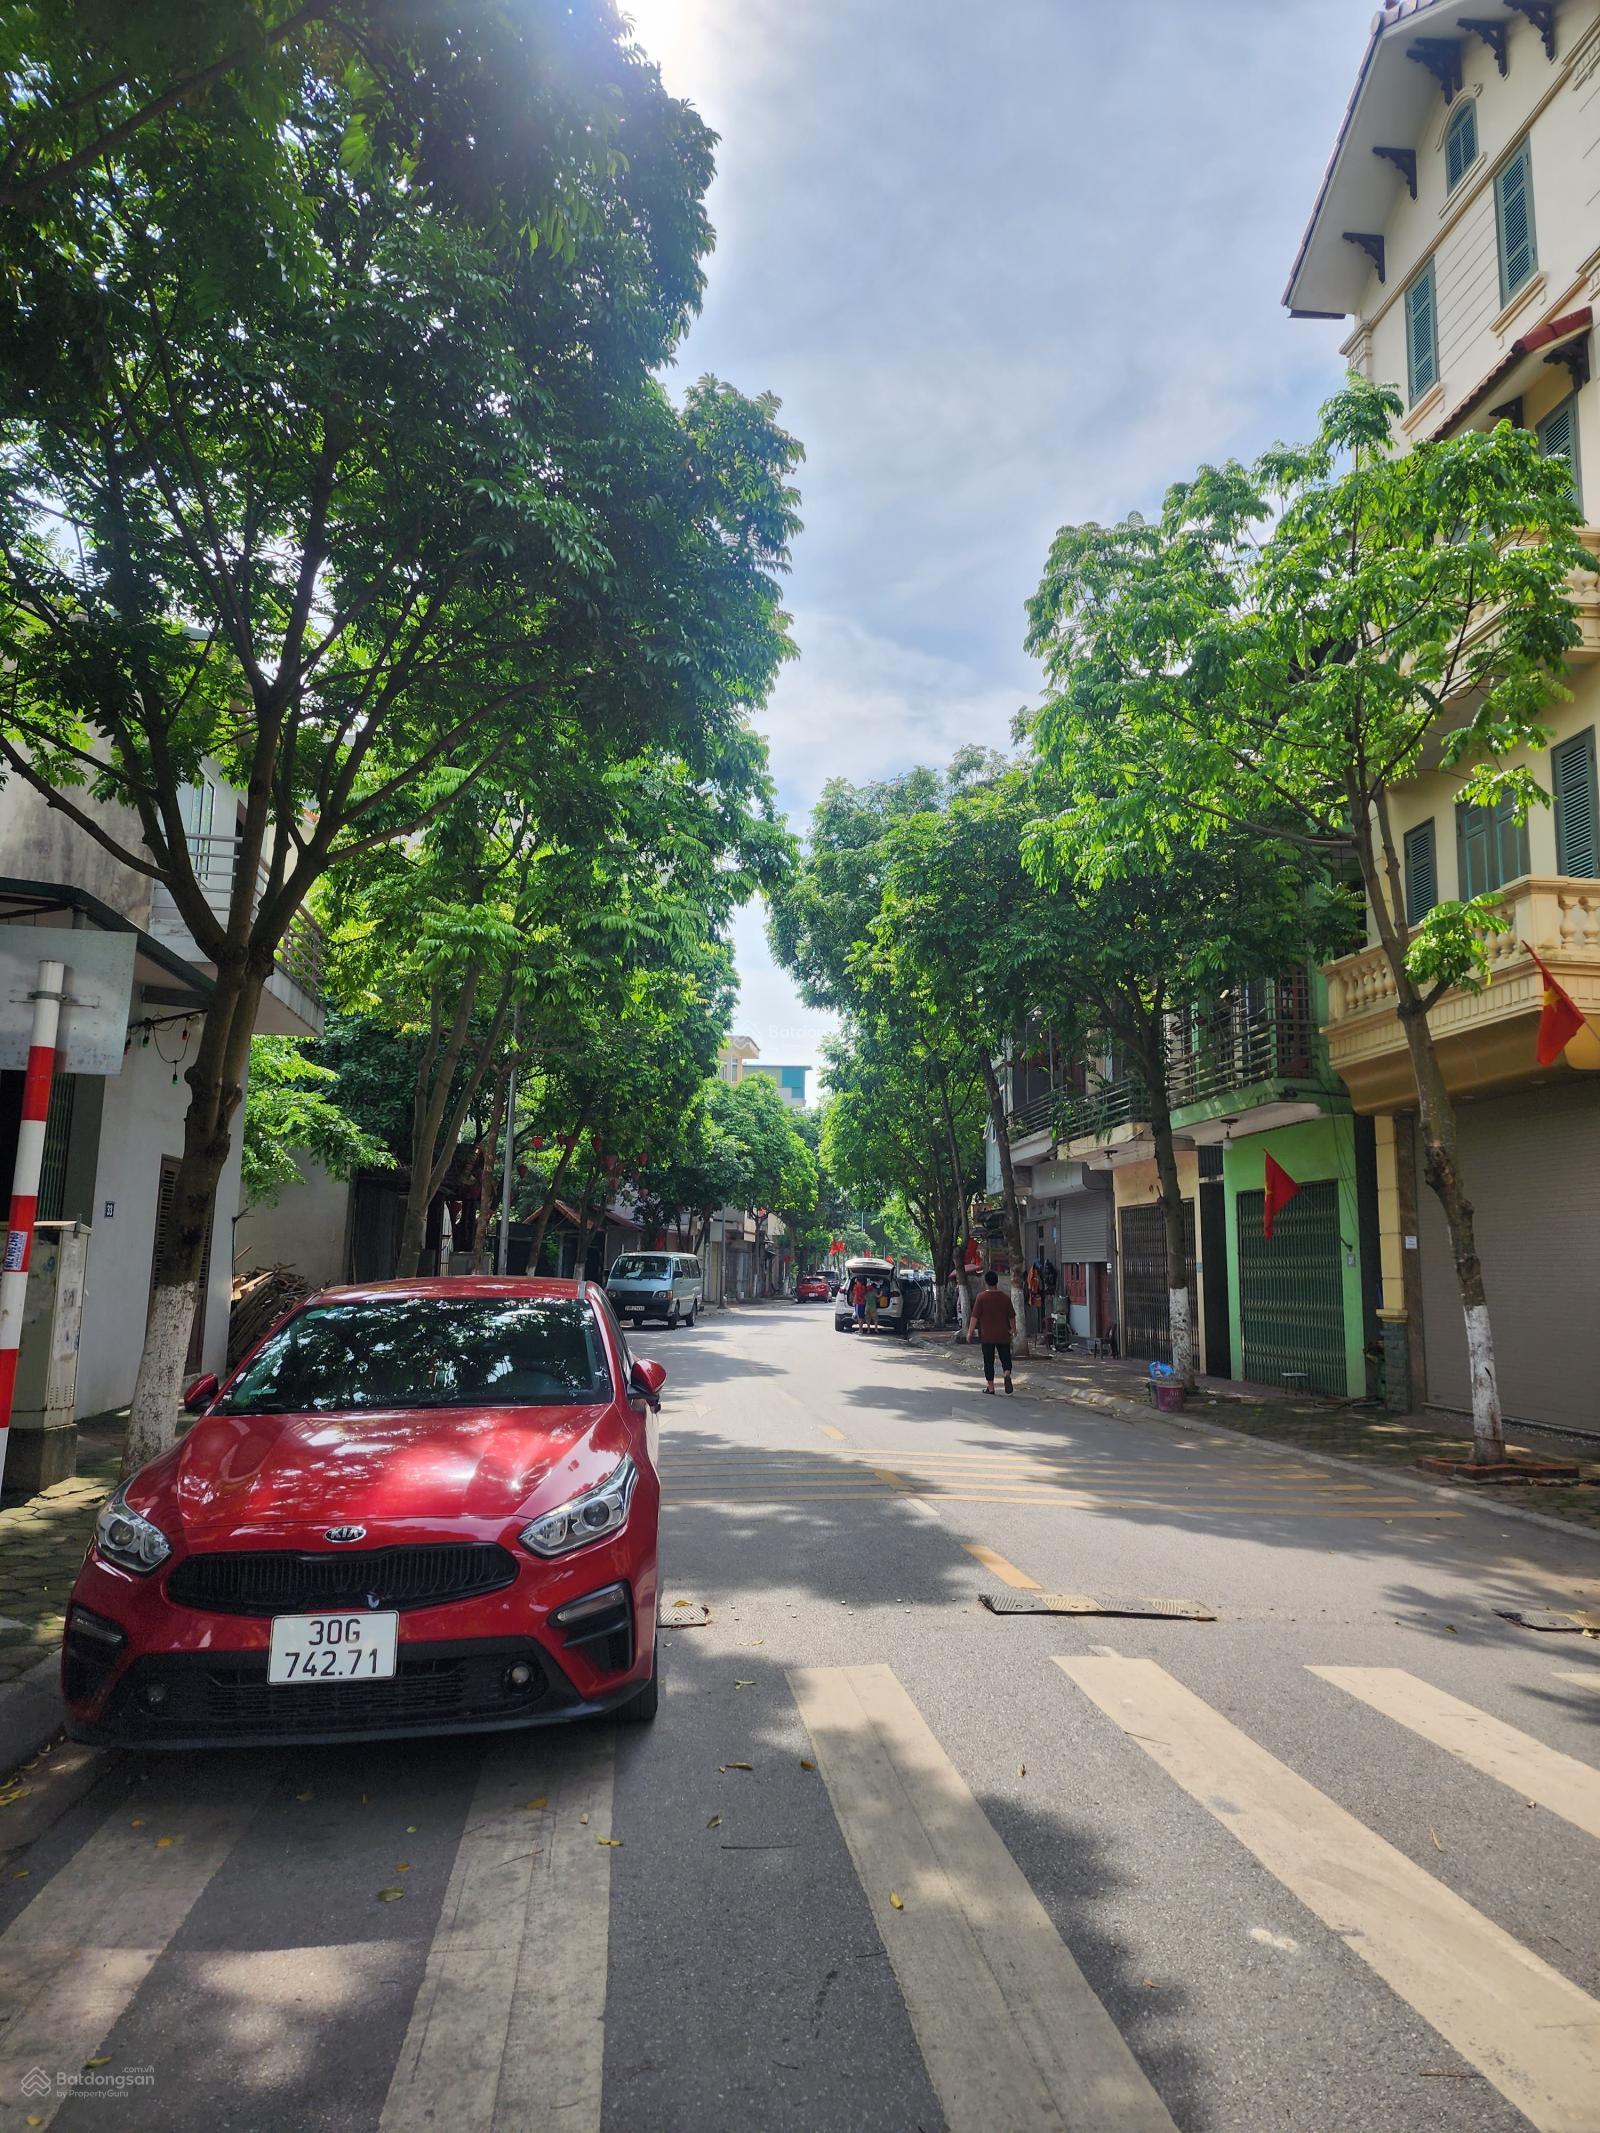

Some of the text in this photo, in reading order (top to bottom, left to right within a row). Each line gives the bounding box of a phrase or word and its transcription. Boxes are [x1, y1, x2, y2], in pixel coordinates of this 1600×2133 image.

[330, 1527, 359, 1539] KIA
[308, 1618, 361, 1646] 30G
[285, 1648, 378, 1679] 742.71
